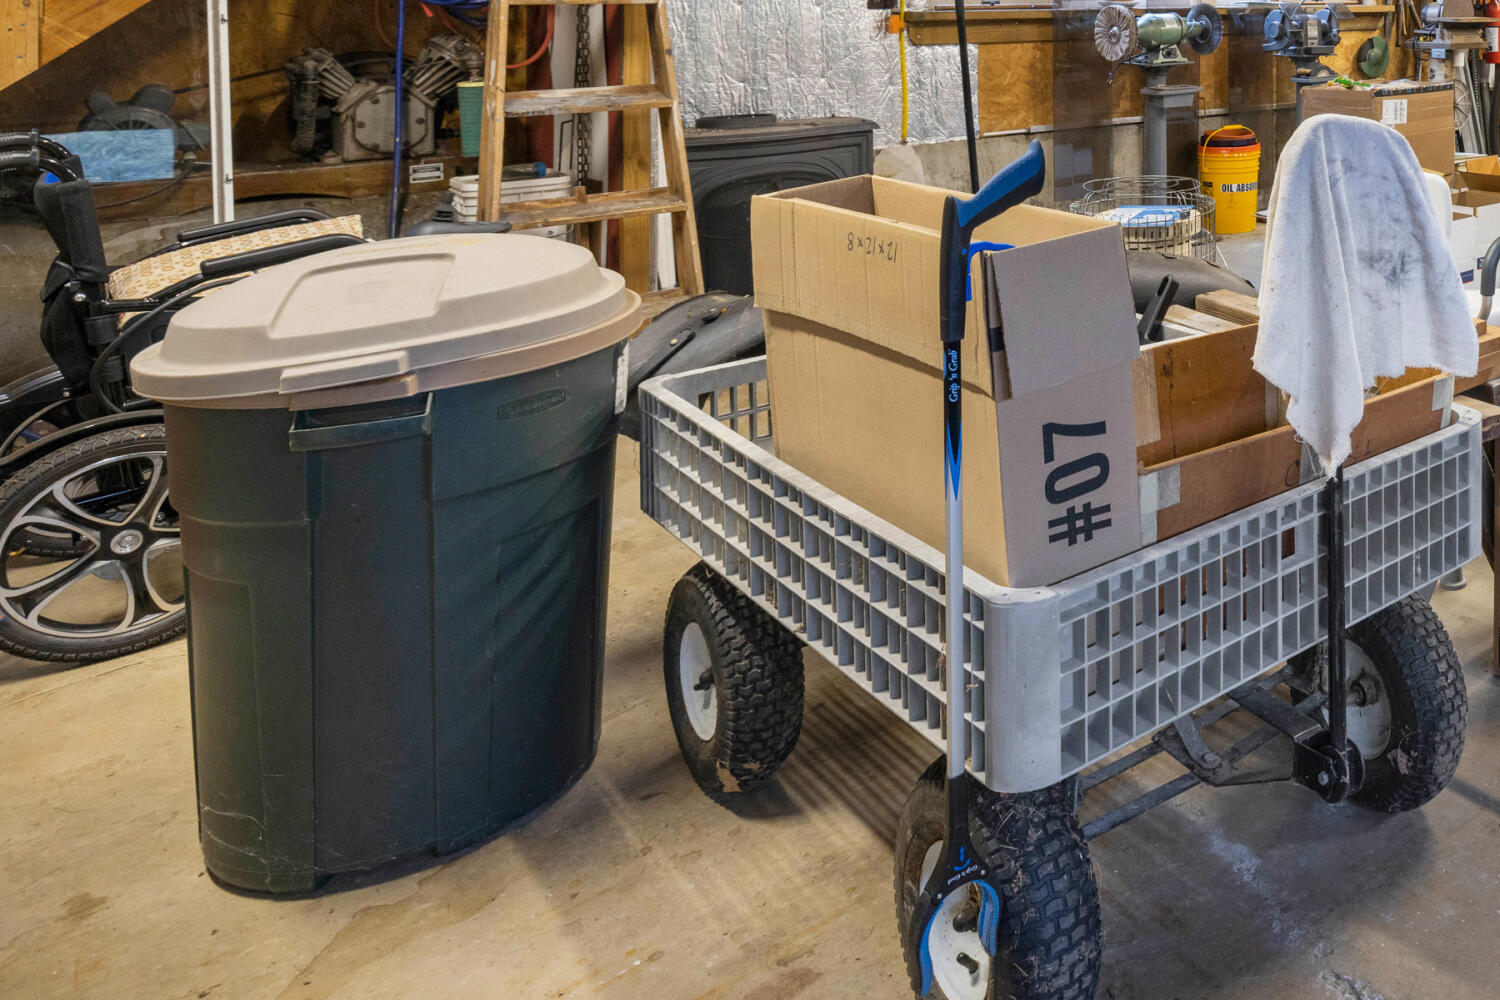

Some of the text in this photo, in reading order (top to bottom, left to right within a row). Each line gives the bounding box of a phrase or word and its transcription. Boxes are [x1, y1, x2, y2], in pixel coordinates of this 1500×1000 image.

[1222, 184, 1233, 192] OIL
[948, 350, 958, 372] Grab
[949, 382, 960, 403] Grip
[1042, 420, 1112, 546] #07
